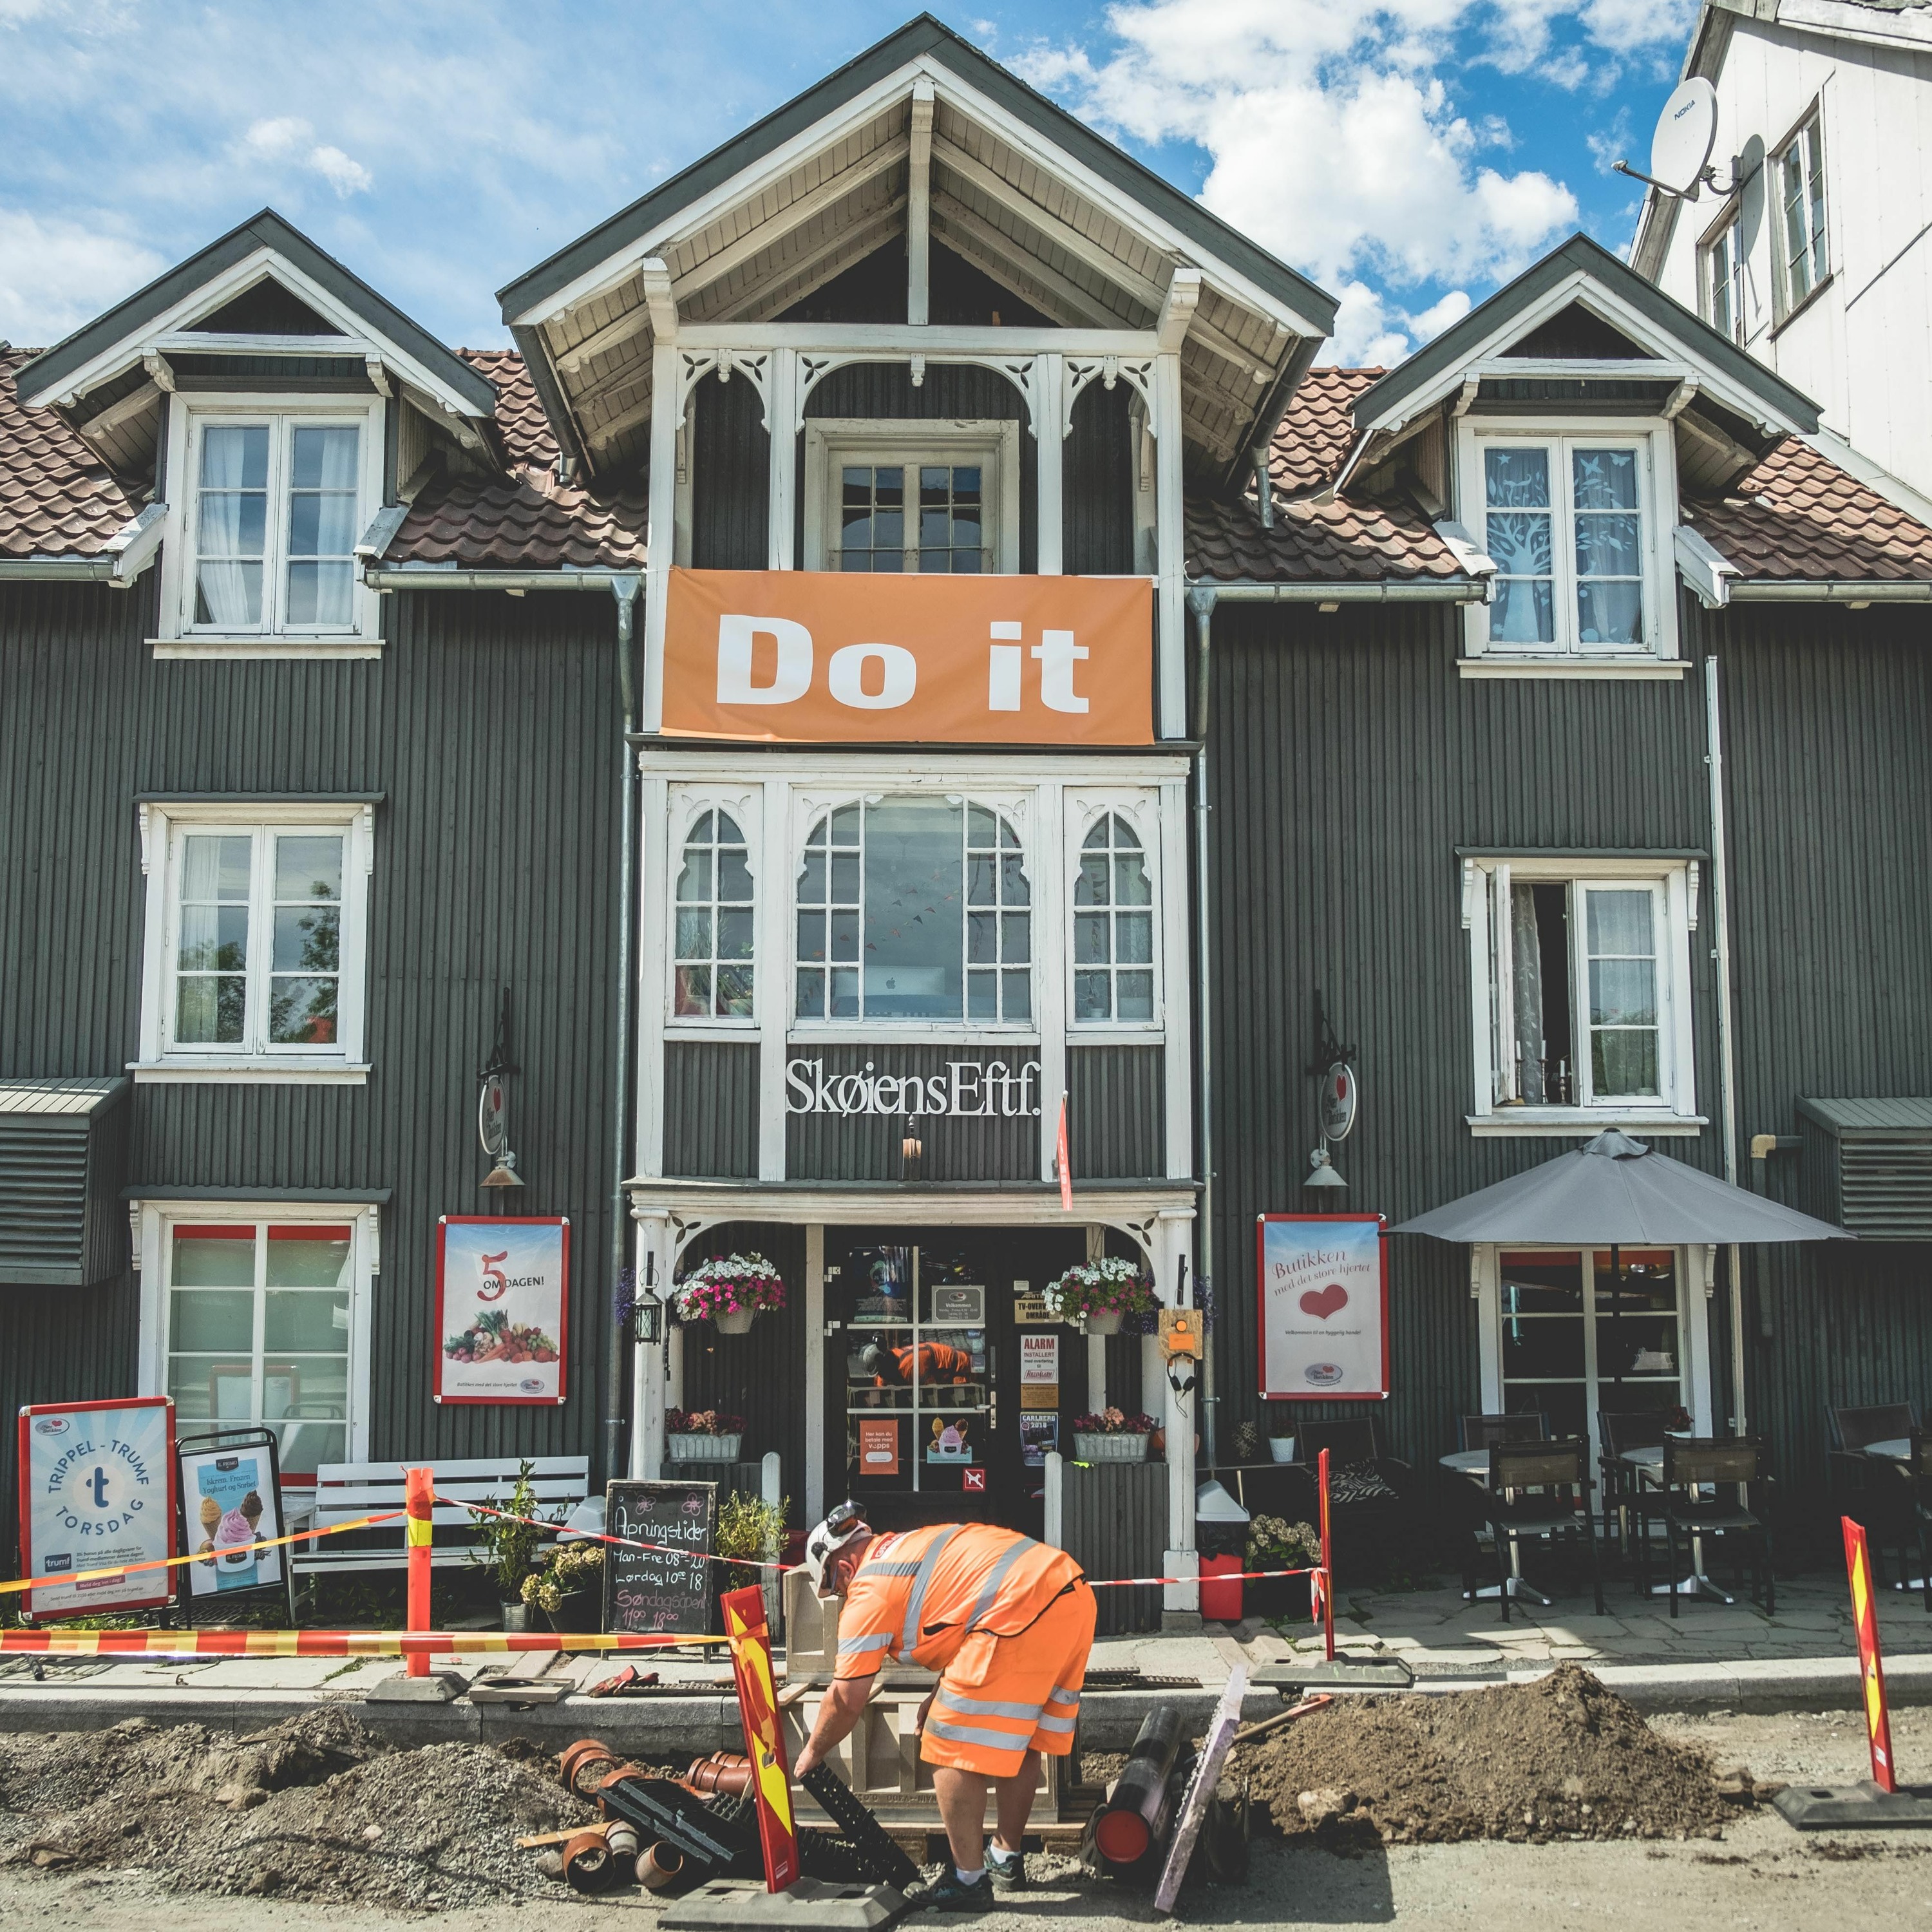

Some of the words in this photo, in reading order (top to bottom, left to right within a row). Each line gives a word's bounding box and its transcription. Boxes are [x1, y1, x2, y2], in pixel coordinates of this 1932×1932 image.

[1674, 99, 1695, 120] NOKIA
[717, 614, 917, 710] Do
[989, 621, 1089, 713] it
[477, 1251, 508, 1301] 5
[1272, 1249, 1347, 1279] Butikken
[484, 1280, 502, 1289] OM
[505, 1276, 544, 1288] DAGEN!
[1274, 1278, 1295, 1296] med
[1297, 1274, 1312, 1286] det
[1314, 1267, 1338, 1280] store
[1340, 1263, 1370, 1276] hjertet
[1026, 1311, 1050, 1319] OMRÅDE
[1024, 1338, 1055, 1350] ALARM
[48, 1440, 96, 1494] TRIPPEL
[111, 1439, 149, 1485] TRUMF
[203, 1484, 227, 1495] Yoghurt
[237, 1481, 256, 1490] Sorbet
[55, 1499, 144, 1535] TORSDAG
[615, 1495, 706, 1546] Åpningstider
[46, 1557, 70, 1567] trumf
[615, 1570, 664, 1587] Lørdag
[690, 1571, 703, 1591] 18
